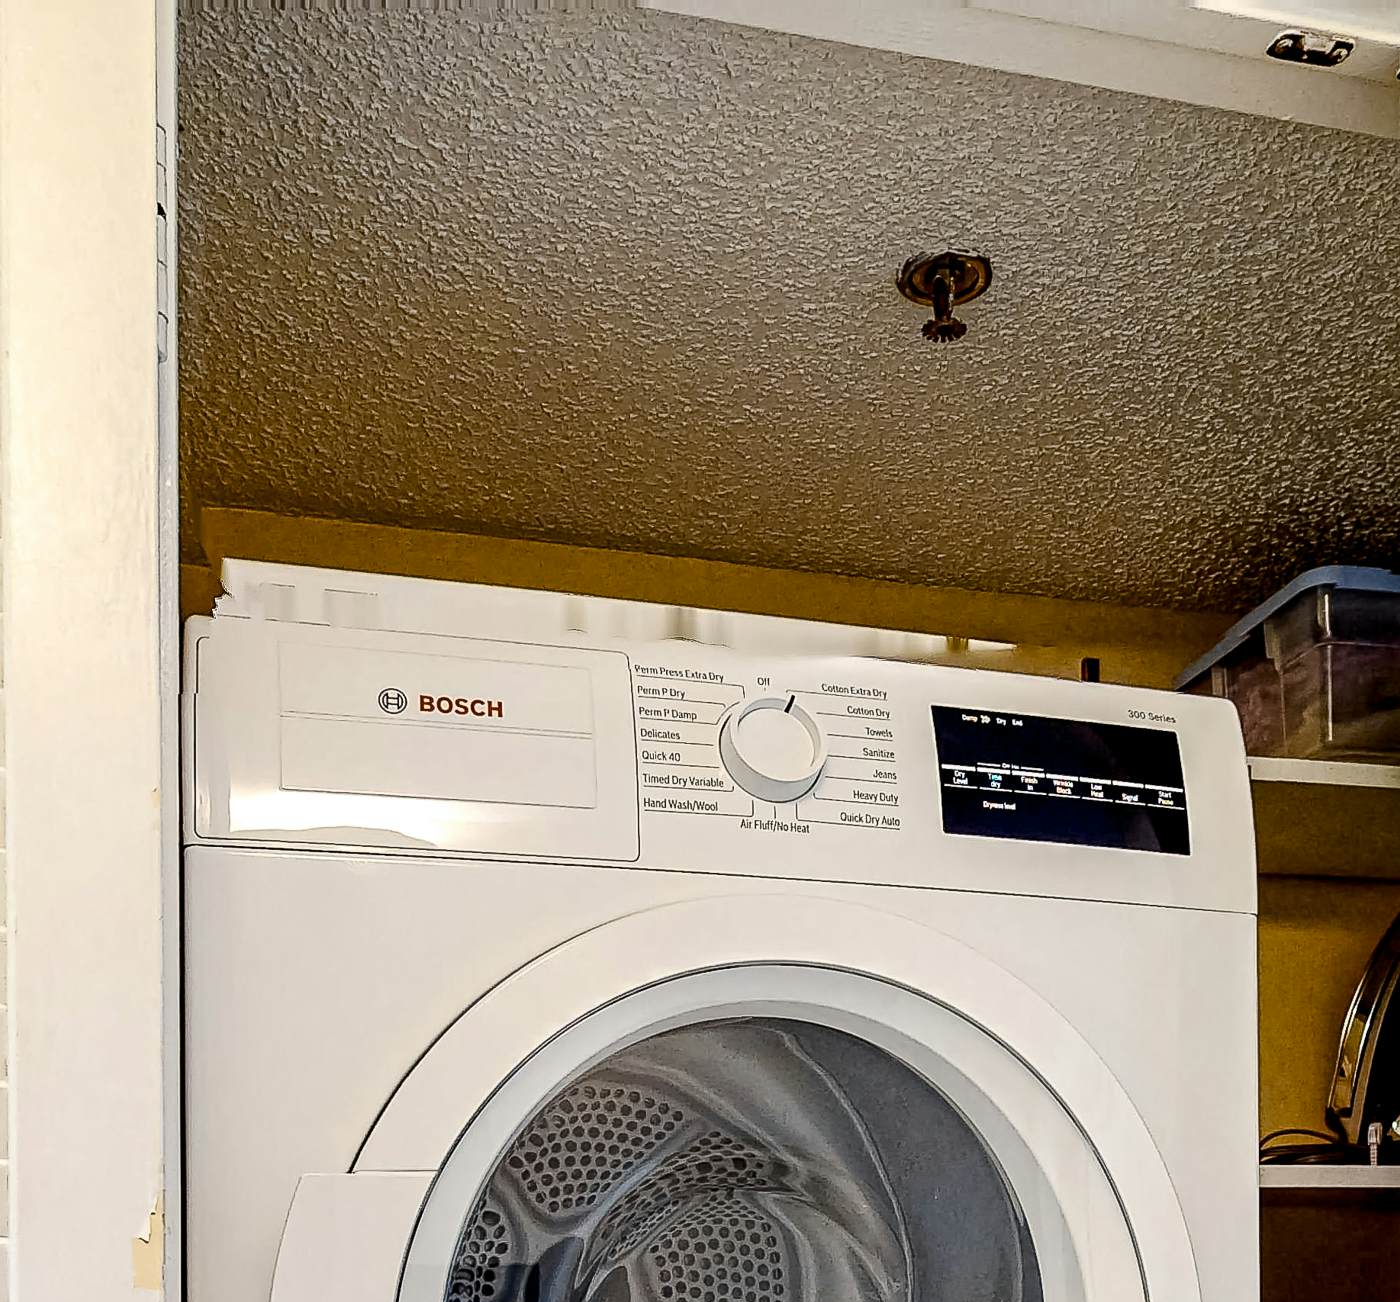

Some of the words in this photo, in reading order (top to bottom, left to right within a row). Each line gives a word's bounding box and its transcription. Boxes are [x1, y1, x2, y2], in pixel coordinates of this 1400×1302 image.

[634, 664, 658, 675] Perm
[659, 666, 684, 678] Press
[684, 669, 708, 680] Extra
[708, 671, 724, 684] Dry
[757, 677, 770, 686] Off
[637, 685, 661, 696] Perm
[661, 687, 669, 696] P
[669, 688, 686, 701] Dry
[821, 683, 850, 694] Cotton
[850, 686, 872, 697] Extra
[872, 689, 888, 701] Dry
[419, 694, 503, 718] BOSCH
[847, 705, 875, 717] Cotton
[875, 709, 891, 720] Dry
[638, 706, 662, 717] Perm
[663, 708, 670, 718] P
[671, 709, 698, 723] Damp
[1127, 709, 1146, 720] 300
[1148, 712, 1176, 724] Series
[640, 728, 681, 740] Delicates
[865, 726, 894, 738] Towels
[641, 750, 668, 761] Quick
[668, 752, 681, 762] 40
[862, 747, 896, 759] Sanitize
[642, 773, 670, 785] Timed
[671, 775, 688, 788] Dry
[688, 776, 724, 788] Variable
[872, 769, 898, 780] Jeans
[643, 797, 667, 809] Hand
[668, 799, 719, 812] Wash/Wool
[853, 790, 879, 801] Heavy
[879, 792, 899, 805] Duty
[740, 818, 752, 829] Air
[754, 819, 789, 833] Fluff/No
[790, 822, 810, 834] Heat
[840, 811, 864, 823] Quick
[865, 814, 880, 827] Dry
[880, 815, 901, 827] Auto
